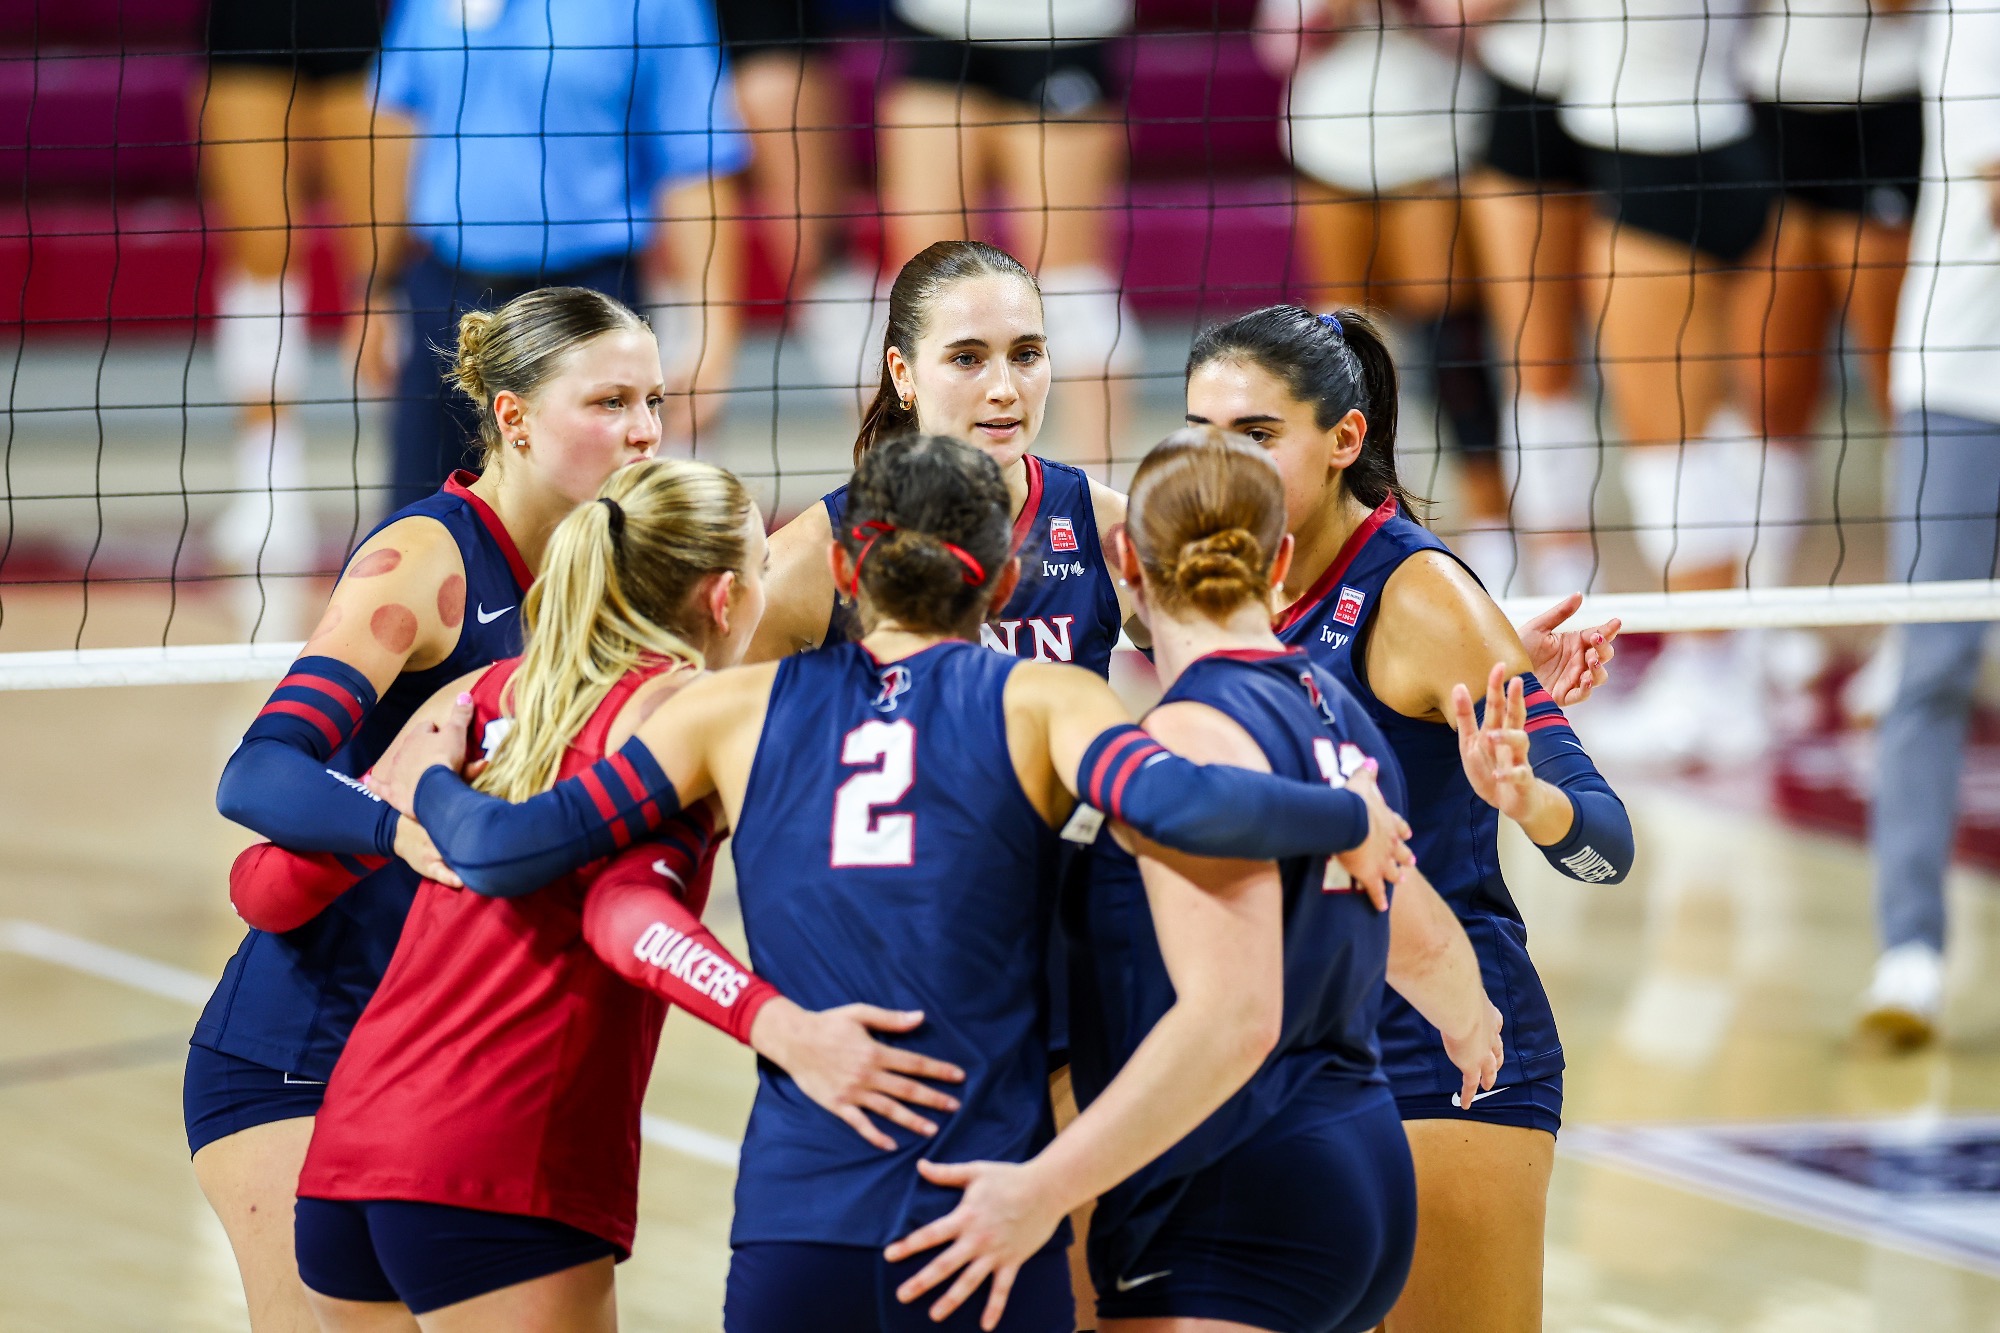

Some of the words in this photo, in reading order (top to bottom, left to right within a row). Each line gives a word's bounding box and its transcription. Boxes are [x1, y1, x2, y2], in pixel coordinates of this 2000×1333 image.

[1042, 560, 1070, 581] Ivy
[1320, 625, 1346, 650] Ivy
[830, 717, 917, 870] 2
[1560, 844, 1618, 884] QUAKERS
[633, 921, 749, 1009] QUAKERS
